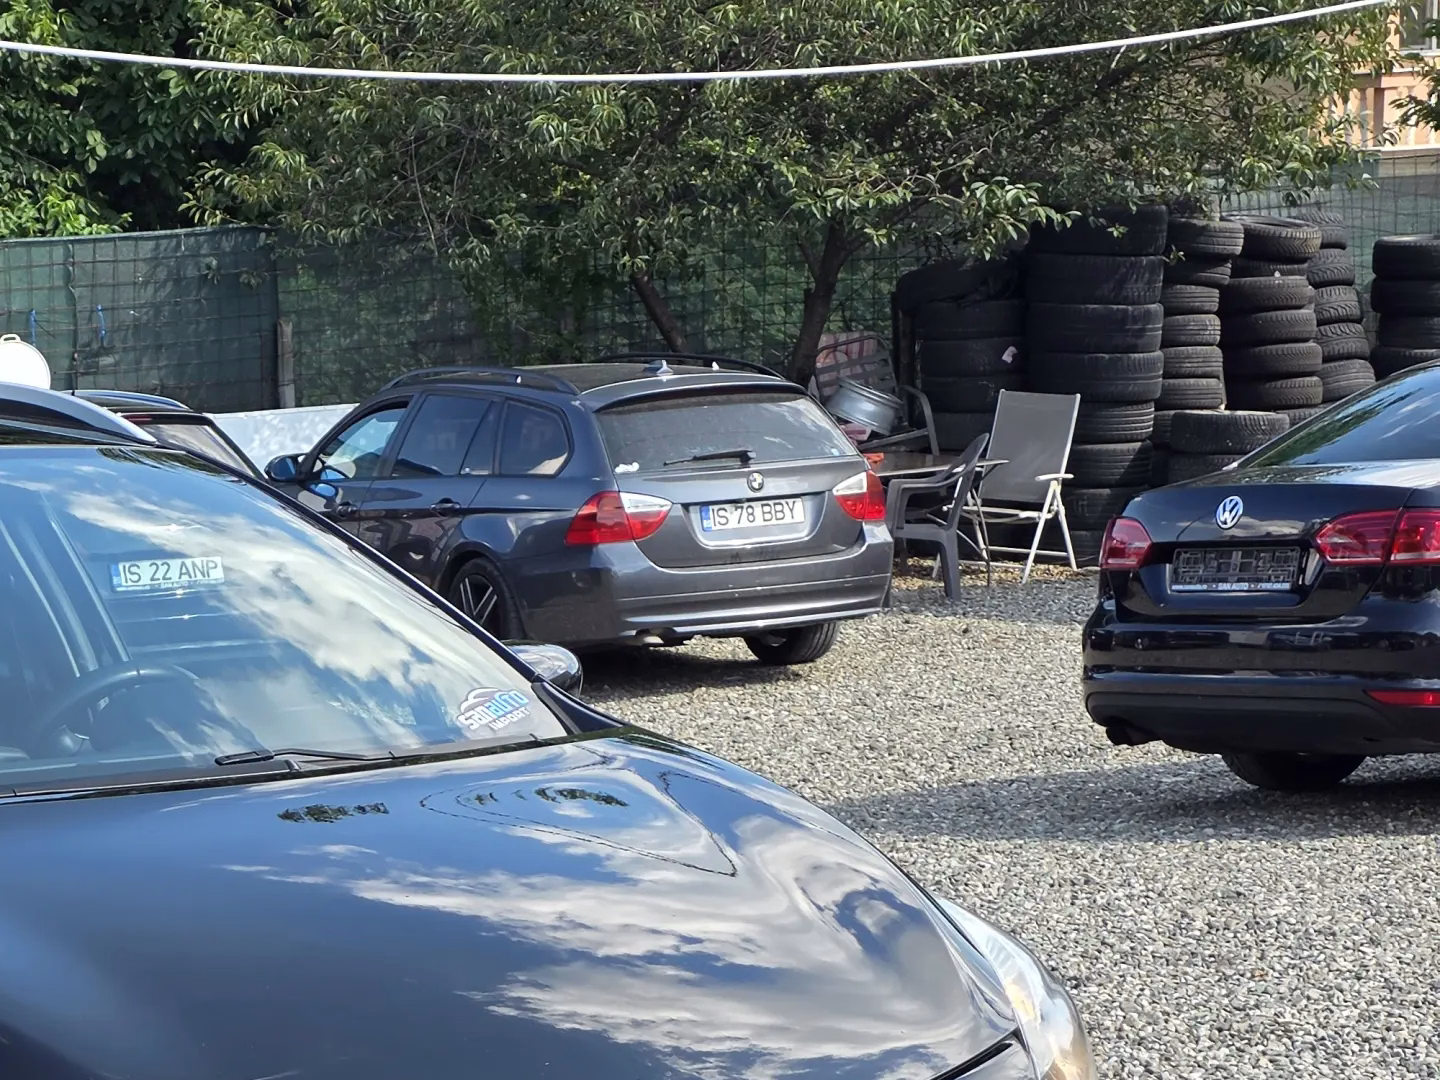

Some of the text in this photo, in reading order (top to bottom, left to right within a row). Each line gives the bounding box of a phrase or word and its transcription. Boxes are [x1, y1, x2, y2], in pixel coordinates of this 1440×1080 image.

[711, 501, 796, 527] IS 78 BBY
[123, 560, 218, 584] IS 22 ANP
[488, 706, 530, 731] IMPORT
